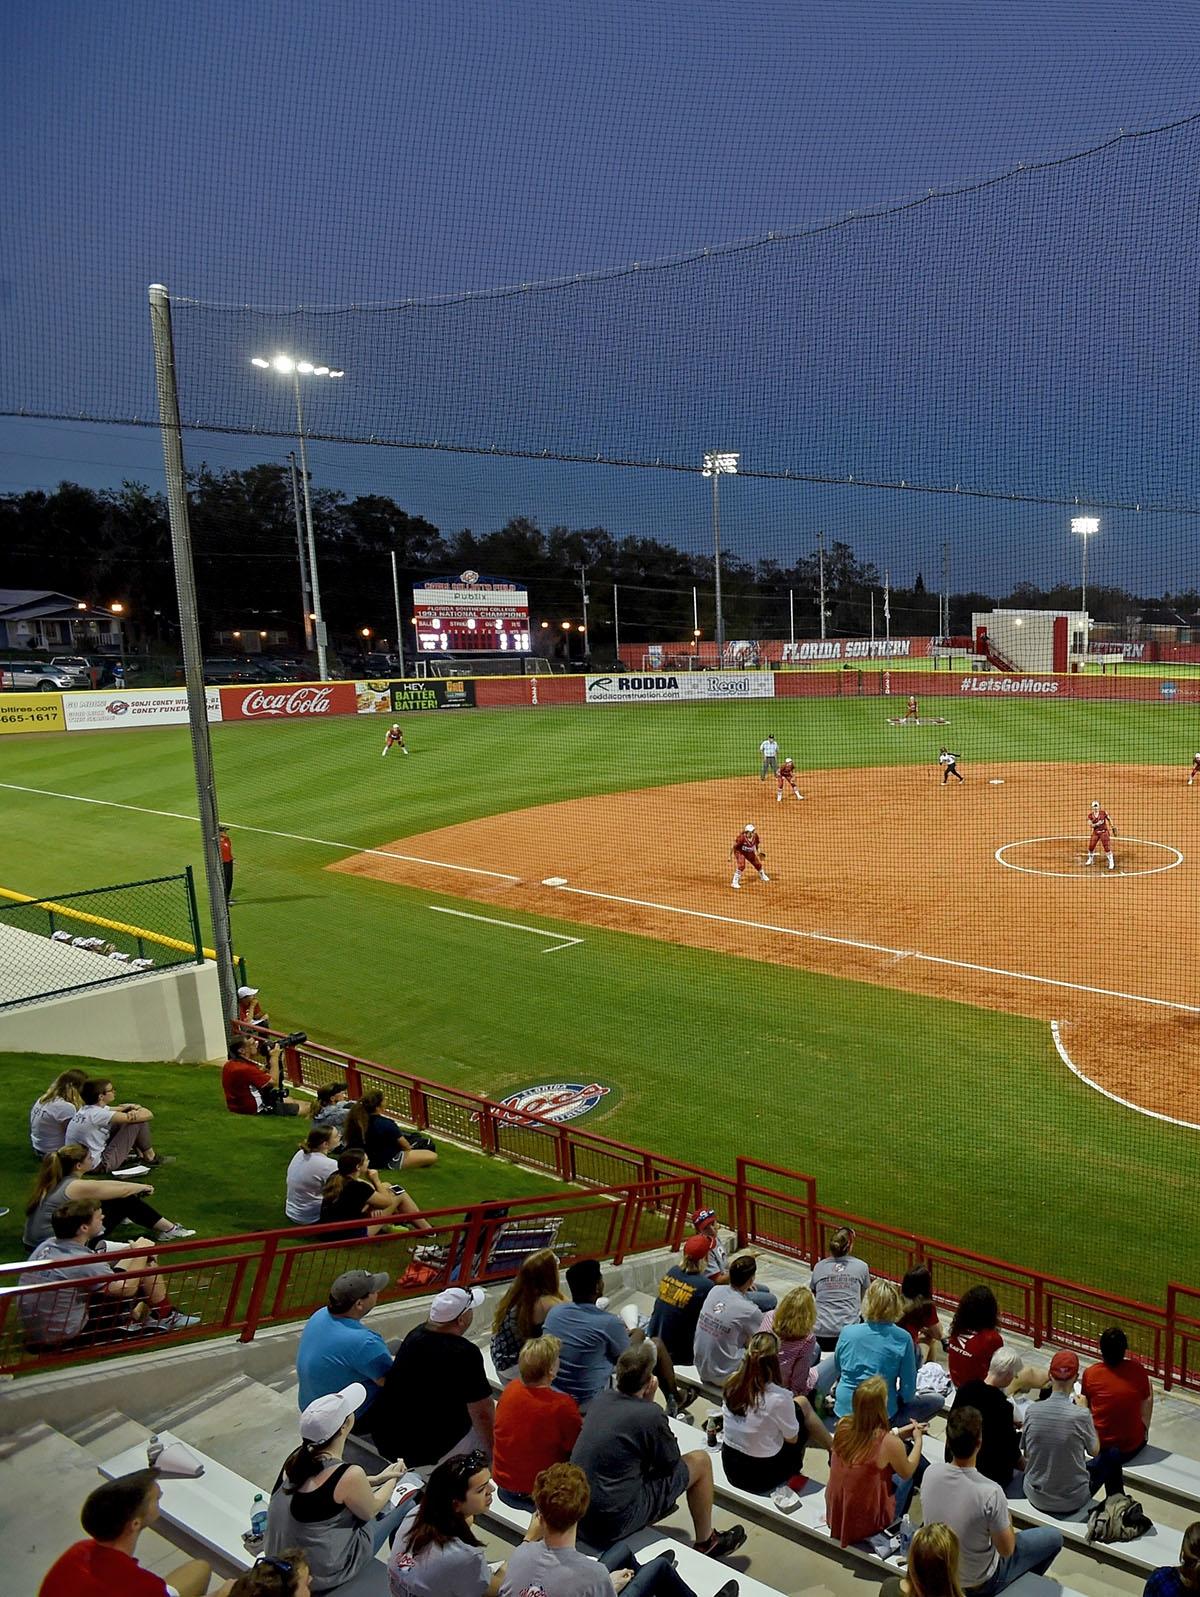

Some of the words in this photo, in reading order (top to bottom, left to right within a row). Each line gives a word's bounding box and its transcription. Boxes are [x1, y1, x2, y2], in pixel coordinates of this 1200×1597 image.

[454, 593, 486, 601] Publix
[781, 642, 841, 660] FLORIDA
[844, 640, 911, 659] SOUTHERN
[403, 683, 426, 691] HEY,
[618, 677, 679, 691] RODDA
[707, 677, 750, 695] Regal
[961, 677, 1059, 693] #LetsGoMocs
[241, 687, 335, 717] Coca-Cola
[395, 691, 436, 701] BATTER
[132, 706, 157, 714] CONEY
[159, 705, 191, 713] FUNERA
[395, 700, 438, 711] BATTER!
[949, 1343, 973, 1358] EASTON
